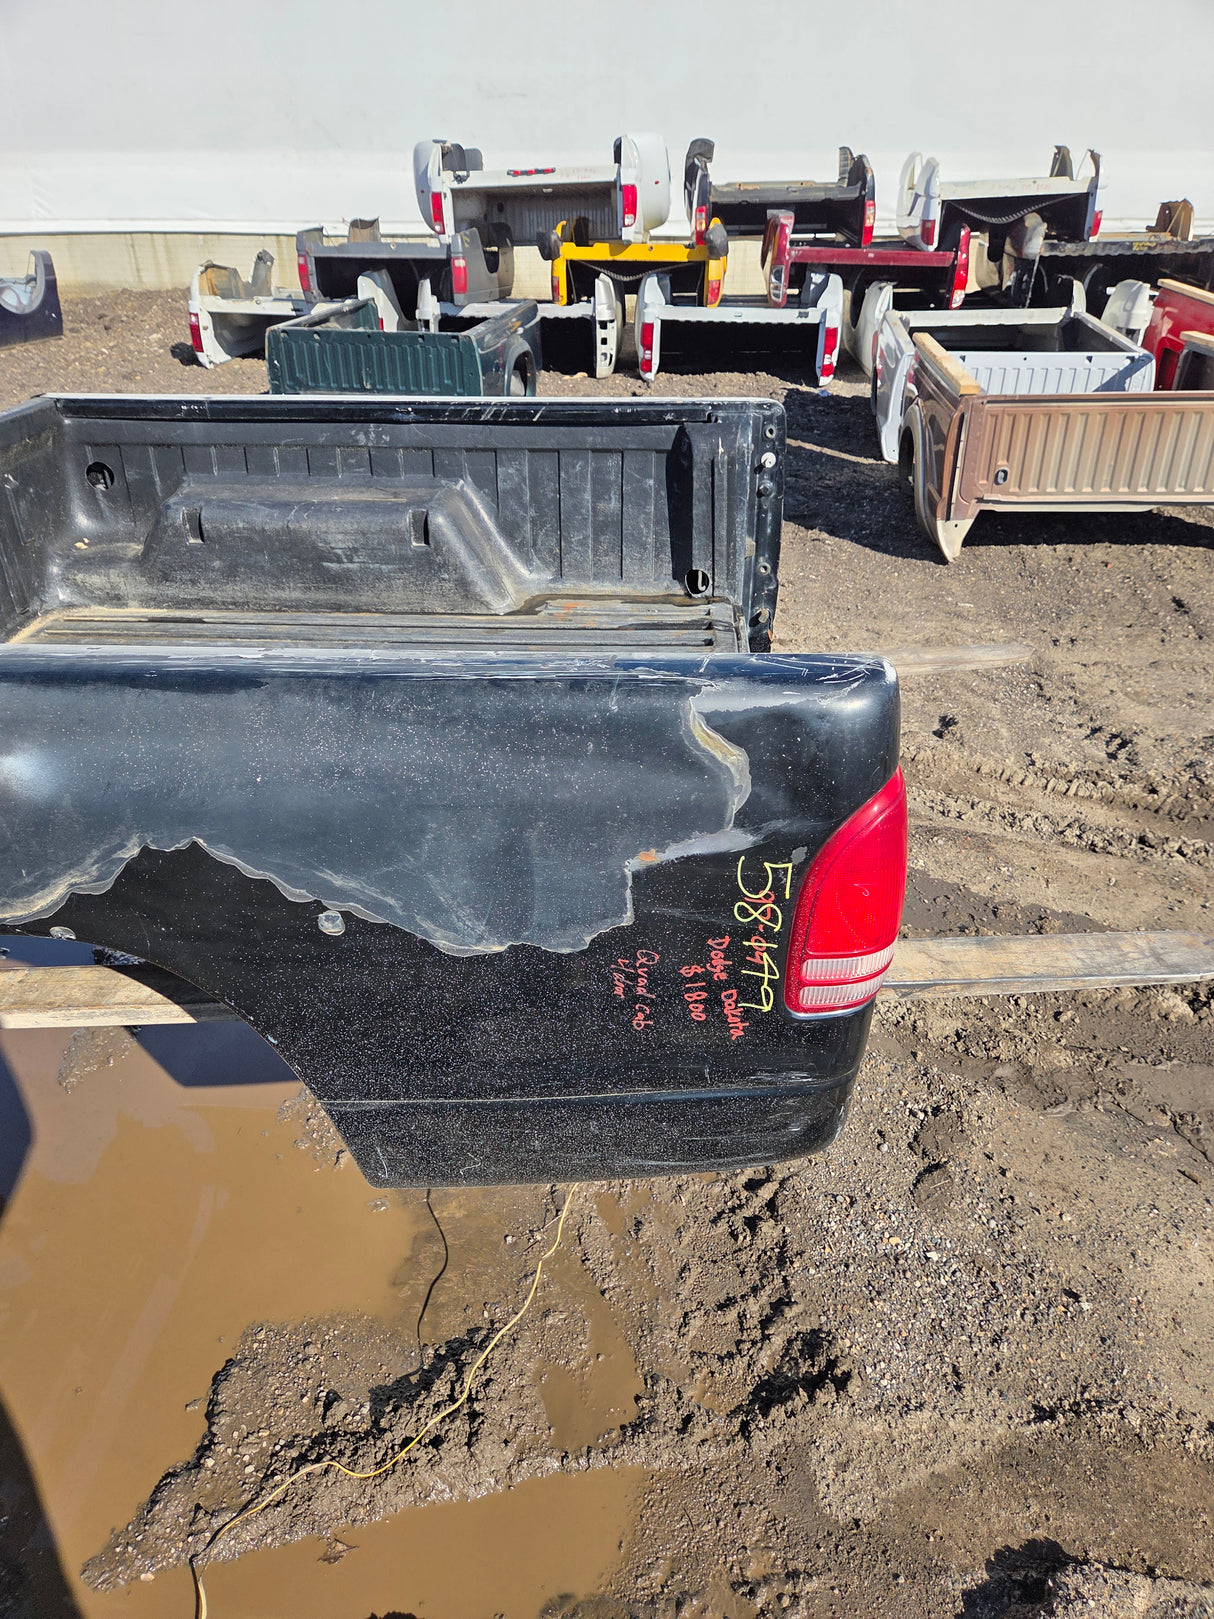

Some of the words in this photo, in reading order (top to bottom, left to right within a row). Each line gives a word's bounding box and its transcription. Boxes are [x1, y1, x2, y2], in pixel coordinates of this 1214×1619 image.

[636, 949, 660, 999] Quad
[706, 935, 733, 981] Dodge
[720, 989, 750, 1040] Dakota
